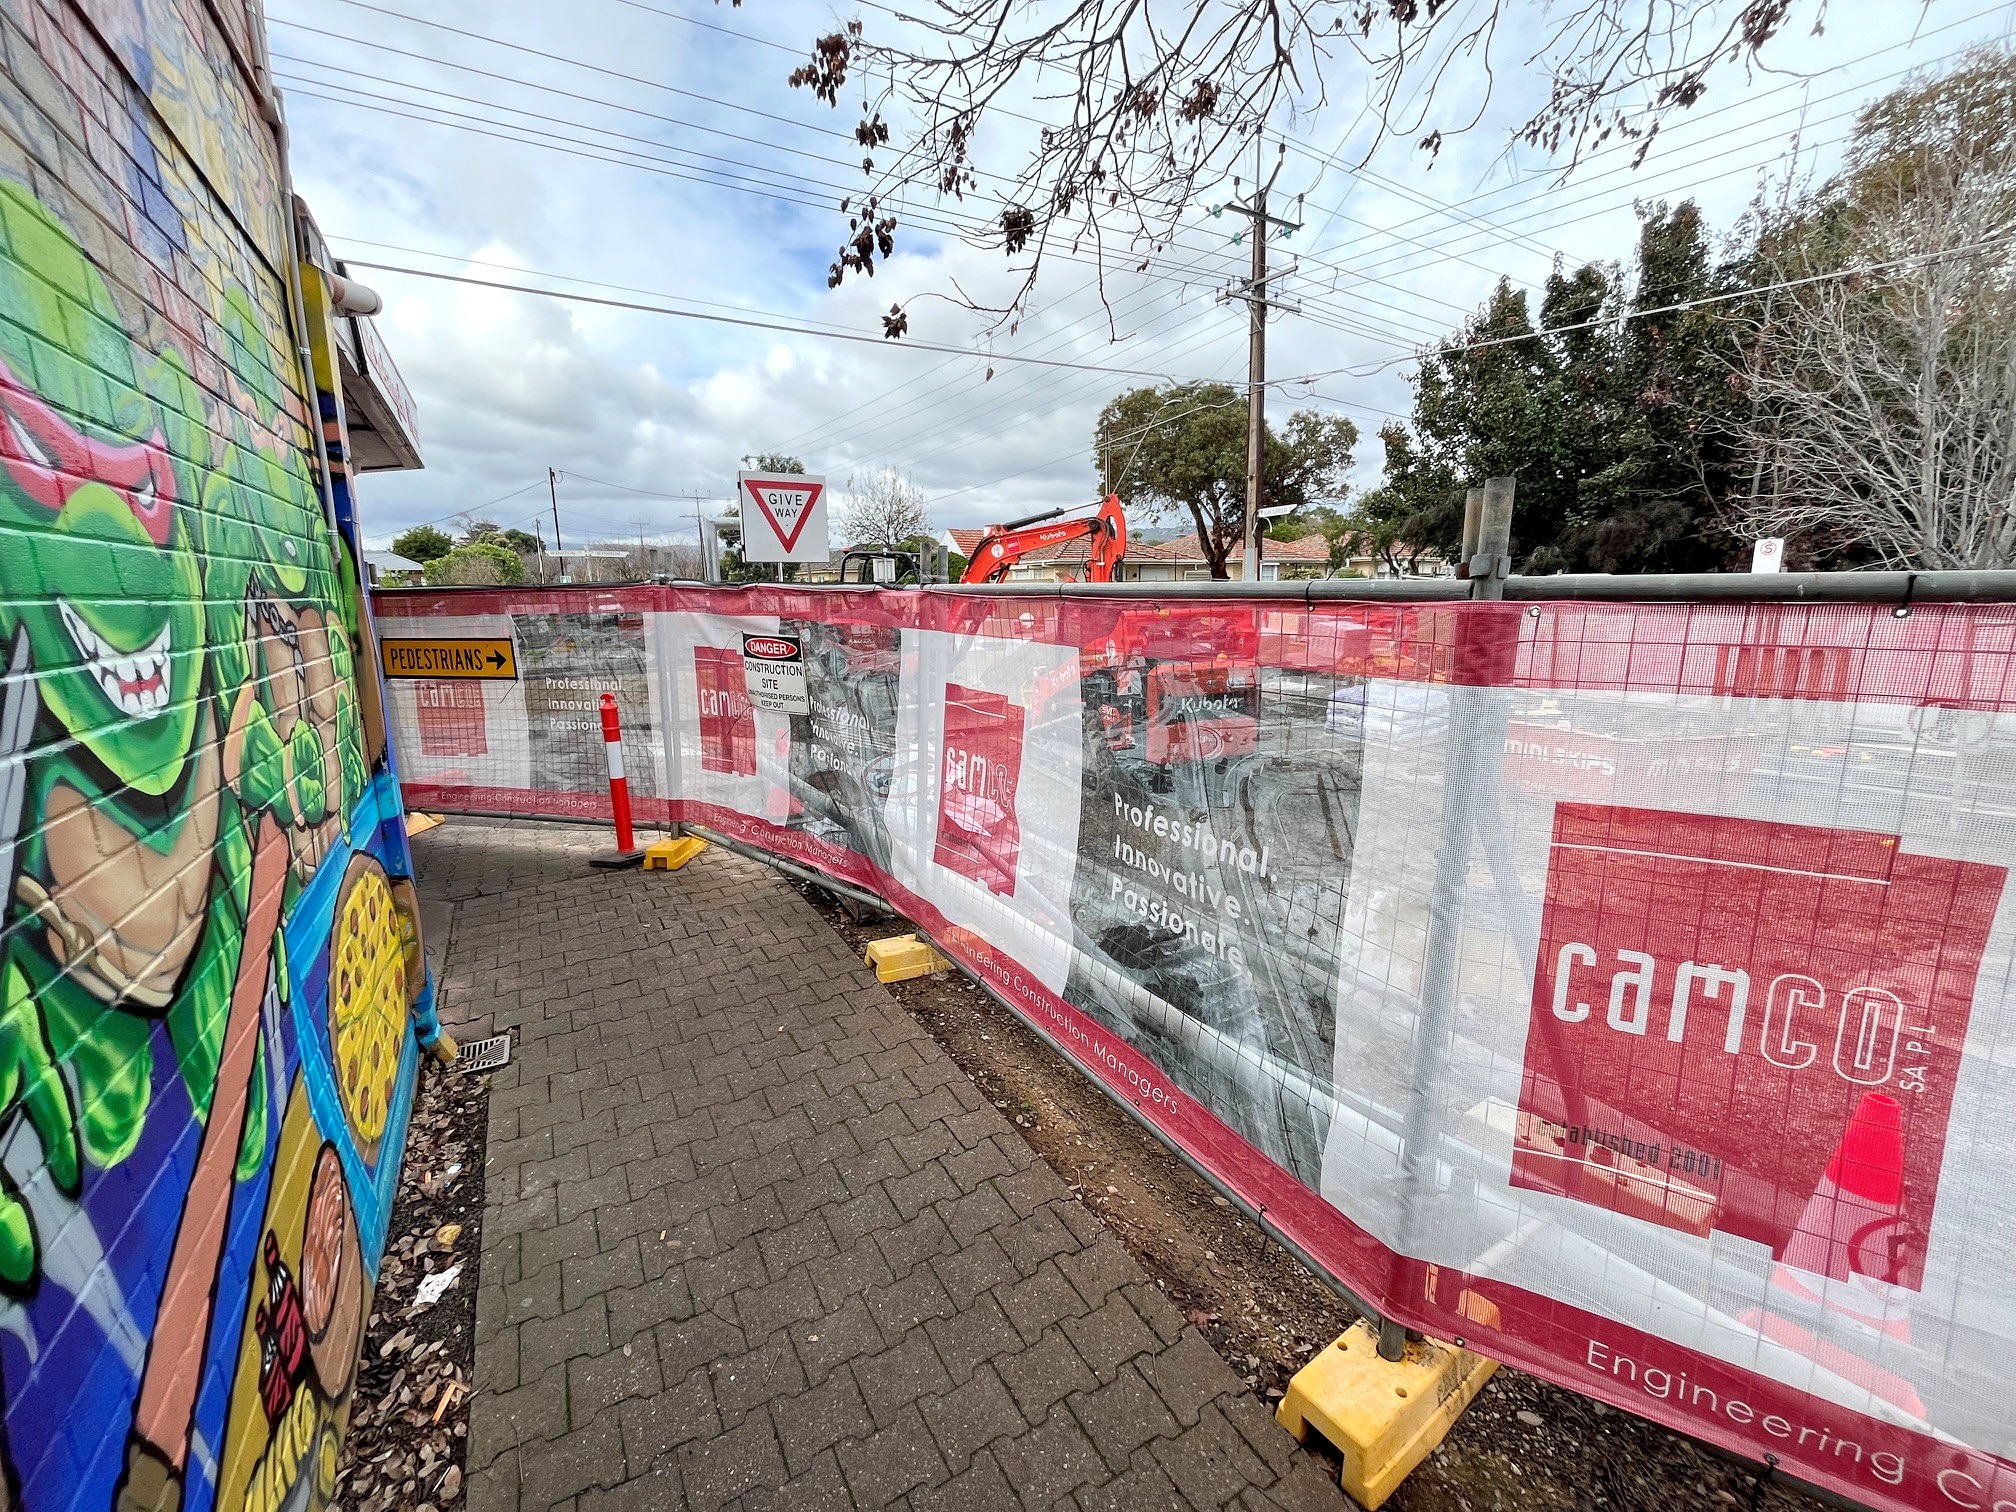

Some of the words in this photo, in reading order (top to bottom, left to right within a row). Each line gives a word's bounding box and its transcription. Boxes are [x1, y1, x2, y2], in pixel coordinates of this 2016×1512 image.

[768, 493, 803, 506] GIVE
[774, 508, 798, 518] WAY
[1040, 530, 1066, 541] Kubota
[750, 641, 788, 655] DANGER
[390, 648, 483, 671] PEDESTRIANS
[744, 660, 803, 677] CONSTRUCTION
[761, 678, 779, 690] SITE
[761, 700, 772, 708] KEEP
[773, 701, 784, 709] OUT
[779, 693, 805, 703] PERSONS
[1181, 694, 1238, 713] Kubota
[1114, 792, 1277, 882] Professional.
[1114, 834, 1250, 926] Innovative.
[1552, 942, 1904, 1086] camco
[1013, 976, 1090, 1047] Construction
[1093, 1040, 1178, 1115] Managers
[1669, 1146, 1721, 1181] 2001
[1585, 1340, 1906, 1486] Engineering
